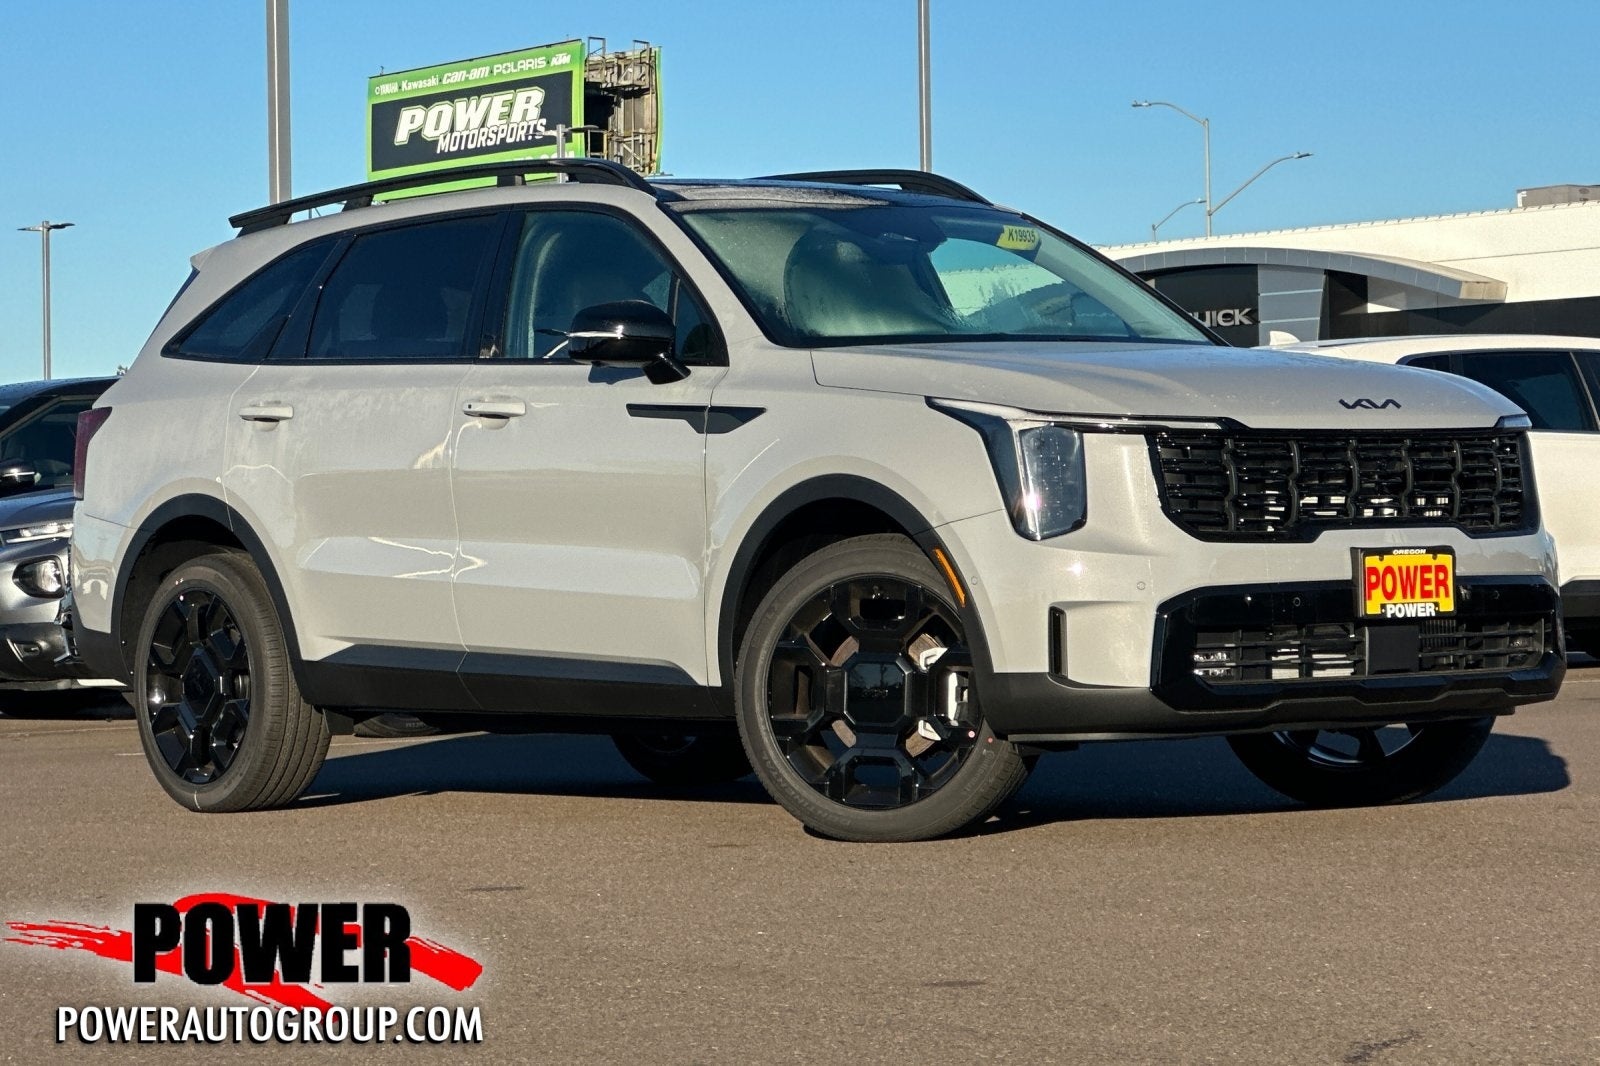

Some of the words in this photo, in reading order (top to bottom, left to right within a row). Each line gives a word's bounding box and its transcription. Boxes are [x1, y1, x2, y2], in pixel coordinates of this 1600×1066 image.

[401, 75, 439, 92] Kawasaki
[493, 56, 546, 76] POLARIS
[550, 53, 571, 66] KTM
[395, 87, 544, 145] POWER
[436, 118, 547, 154] MOTORSPORTS
[1188, 308, 1253, 328] UICK
[1365, 565, 1450, 601] POWER
[1386, 602, 1436, 618] POWER
